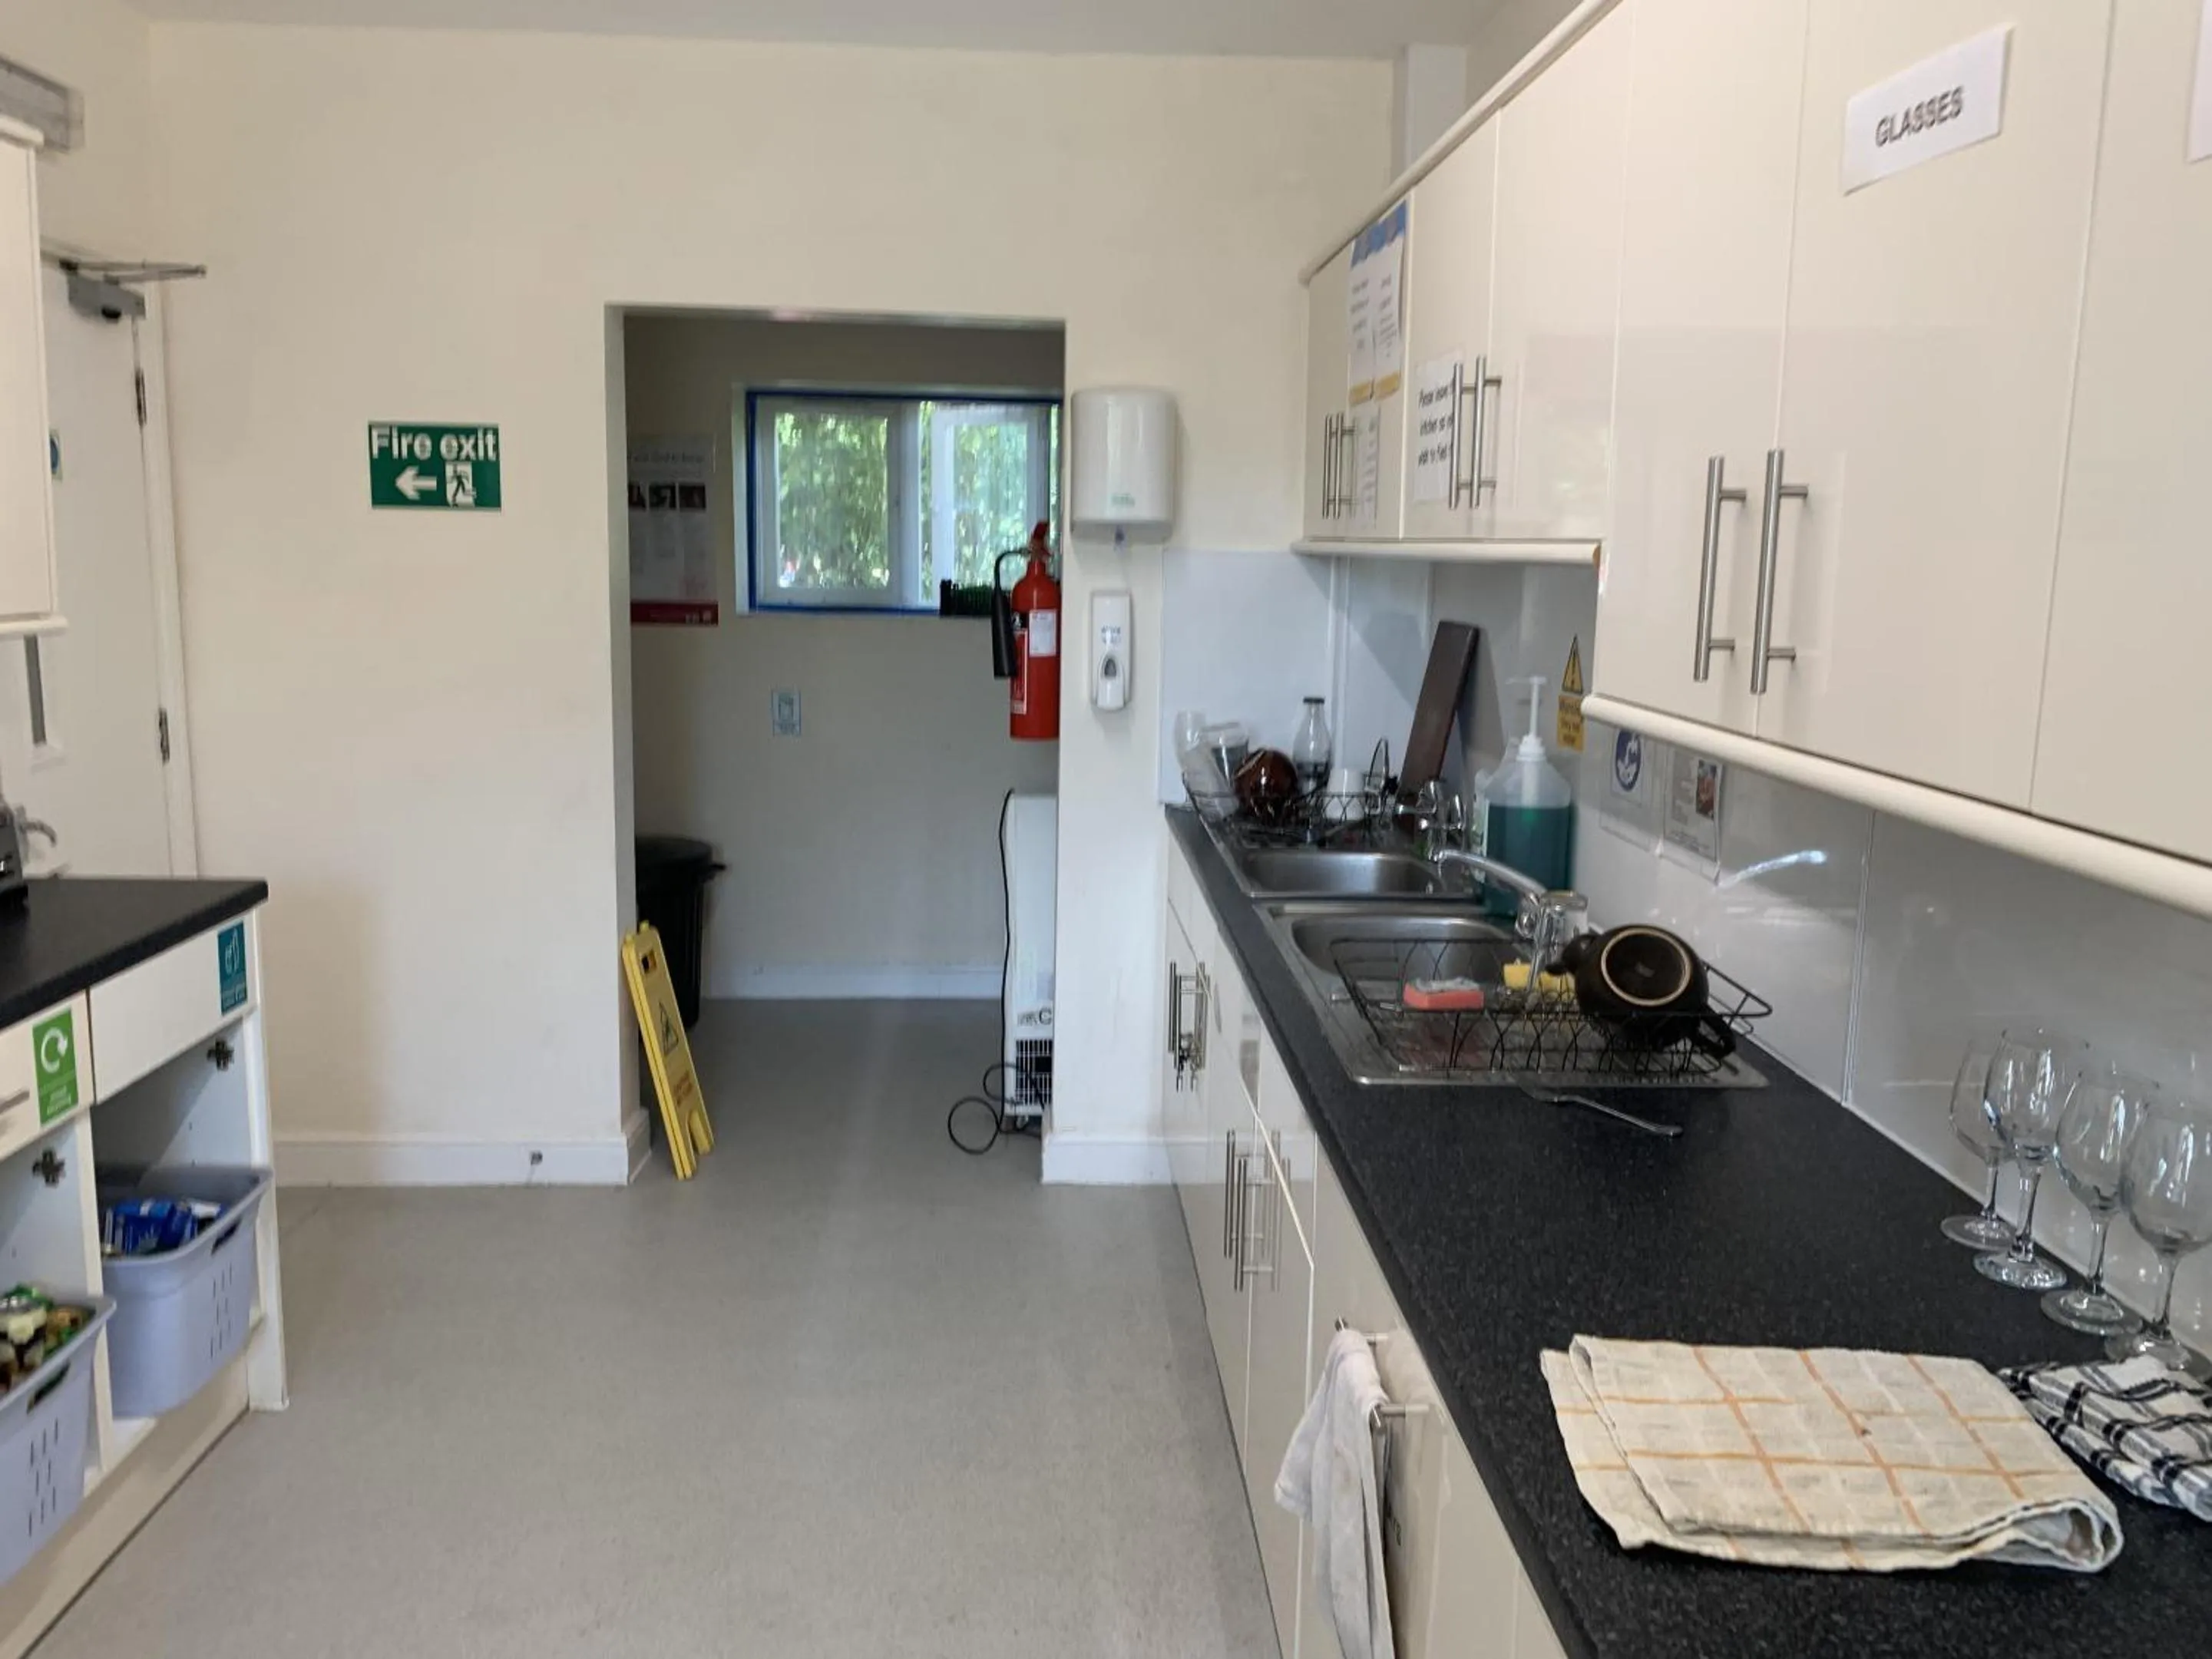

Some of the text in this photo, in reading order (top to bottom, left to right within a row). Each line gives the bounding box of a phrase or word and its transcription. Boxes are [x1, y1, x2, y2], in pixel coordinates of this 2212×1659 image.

[1875, 85, 1963, 145] GLASSES
[372, 426, 497, 461] Fire exit
